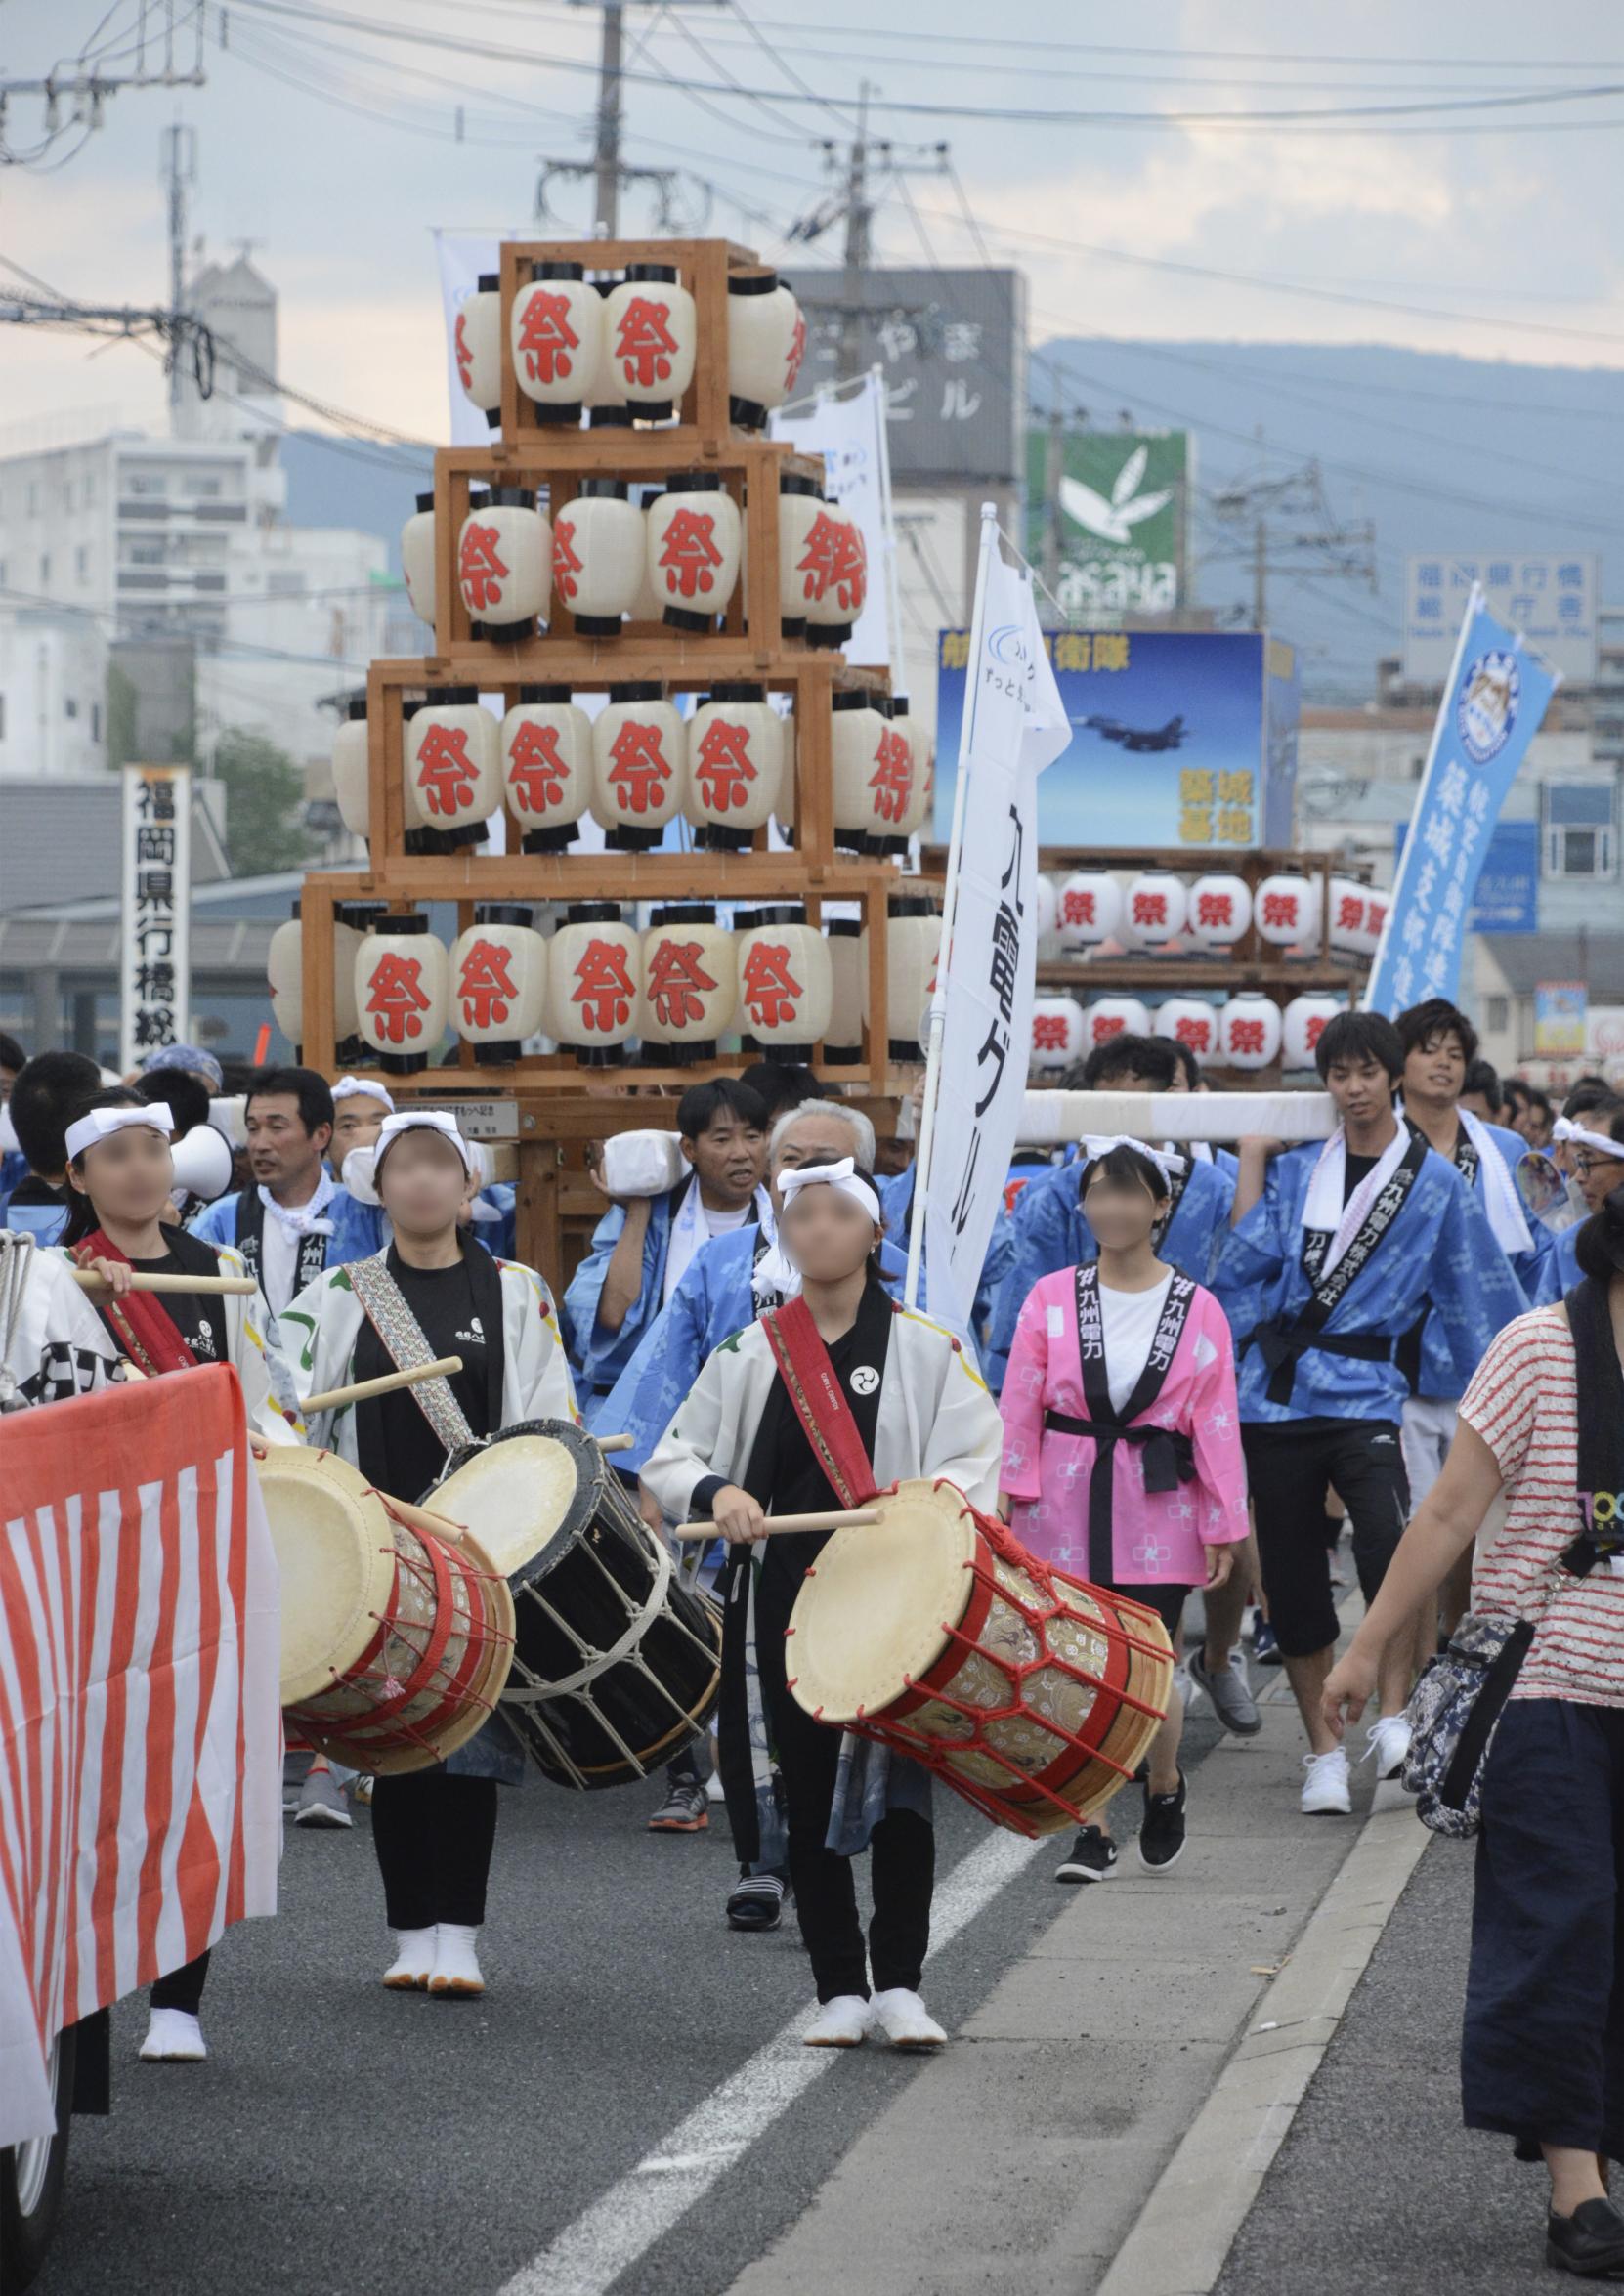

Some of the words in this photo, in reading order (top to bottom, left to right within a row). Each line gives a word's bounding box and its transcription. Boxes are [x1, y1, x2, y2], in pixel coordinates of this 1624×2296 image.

[518, 290, 580, 384] 祭
[615, 297, 679, 387] 祭
[460, 523, 510, 610] 祭
[658, 508, 724, 598] 祭
[941, 631, 1130, 673] 航衛隊
[417, 723, 481, 815] 祭
[508, 720, 571, 813] 祭
[608, 720, 672, 813] 祭
[696, 718, 758, 812] 祭
[135, 779, 177, 1071] 福岡県行橋総
[1064, 890, 1095, 925] 祭
[1133, 893, 1167, 925] 祭
[1198, 893, 1233, 927] 祭
[1263, 893, 1299, 927] 祭
[365, 953, 431, 1043] 祭
[457, 939, 519, 1029] 祭
[571, 939, 636, 1032] 祭
[648, 939, 718, 1028] 祭
[743, 942, 803, 1028] 祭
[1033, 1015, 1069, 1051] 祭
[1229, 1019, 1265, 1054] 祭
[299, 1232, 326, 1291] 九州電
[1079, 1289, 1103, 1360] 九州電力
[1148, 1299, 1184, 1372] 九州電力
